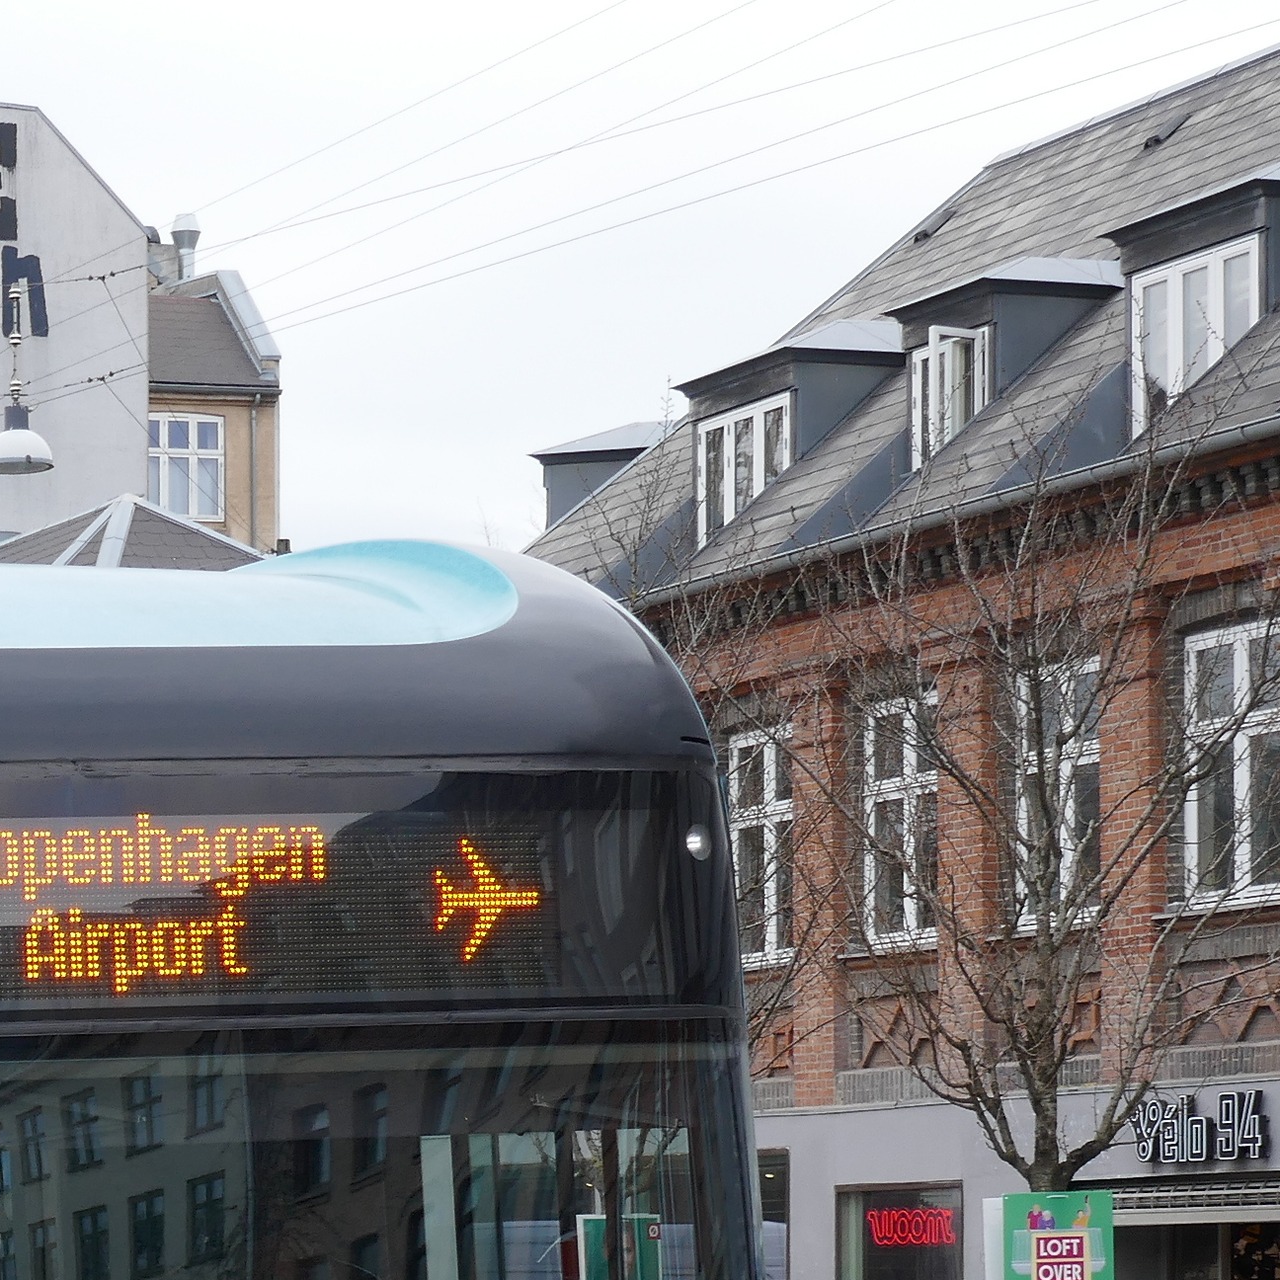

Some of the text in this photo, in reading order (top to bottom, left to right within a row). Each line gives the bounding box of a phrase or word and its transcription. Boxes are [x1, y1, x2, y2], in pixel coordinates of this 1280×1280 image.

[24, 906, 247, 994] Airport
[1217, 1091, 1261, 1158] 94
[1040, 1239, 1080, 1256] LOFT
[1039, 1264, 1082, 1280] OVER
